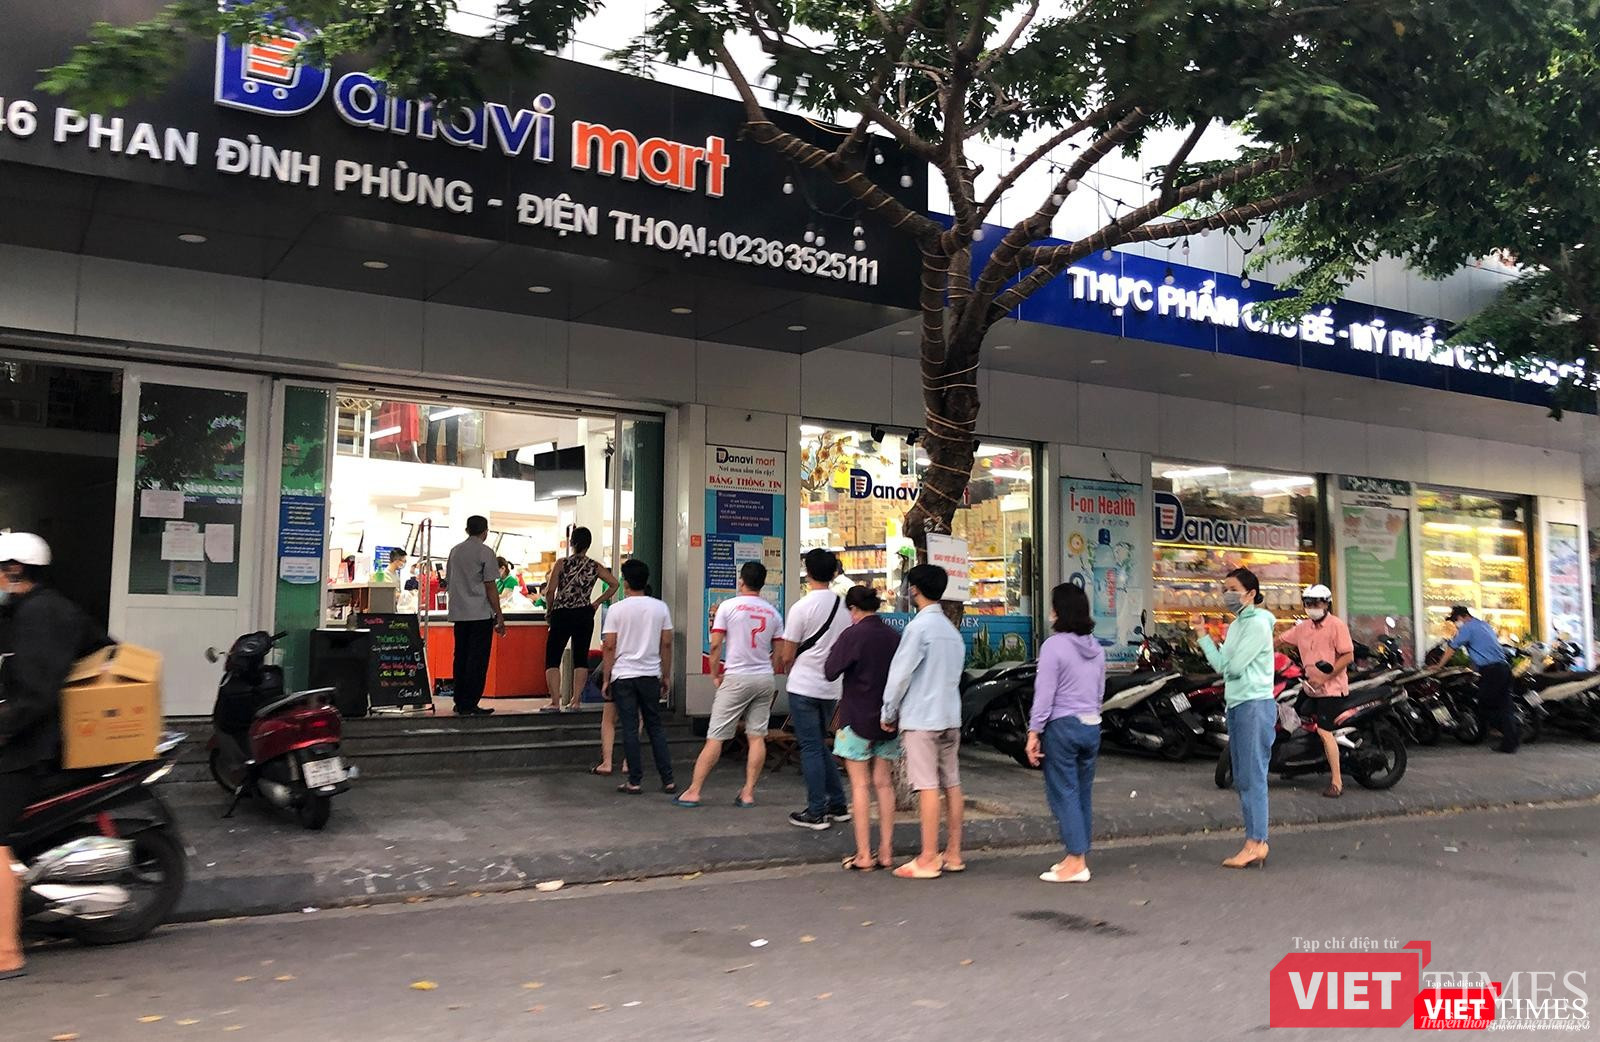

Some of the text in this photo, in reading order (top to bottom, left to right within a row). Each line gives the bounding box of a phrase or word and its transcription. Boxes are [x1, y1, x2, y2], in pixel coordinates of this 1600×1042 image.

[53, 106, 200, 166] PHAN
[215, 134, 320, 187] ĐÌNH
[334, 160, 474, 214] PHÙNG
[517, 192, 599, 237] ĐIỆN
[570, 119, 731, 198] mart
[1066, 265, 1154, 316] THỰC
[1157, 279, 1239, 328] PHẨM
[1301, 307, 1336, 346] BÉ
[1351, 318, 1388, 354] MỸ
[716, 447, 776, 466] Danavi mart
[709, 473, 783, 489] BẢNG THÔNG TIN
[1097, 495, 1137, 517] Health
[1153, 490, 1298, 551] Danavi mart
[750, 614, 766, 649] 7
